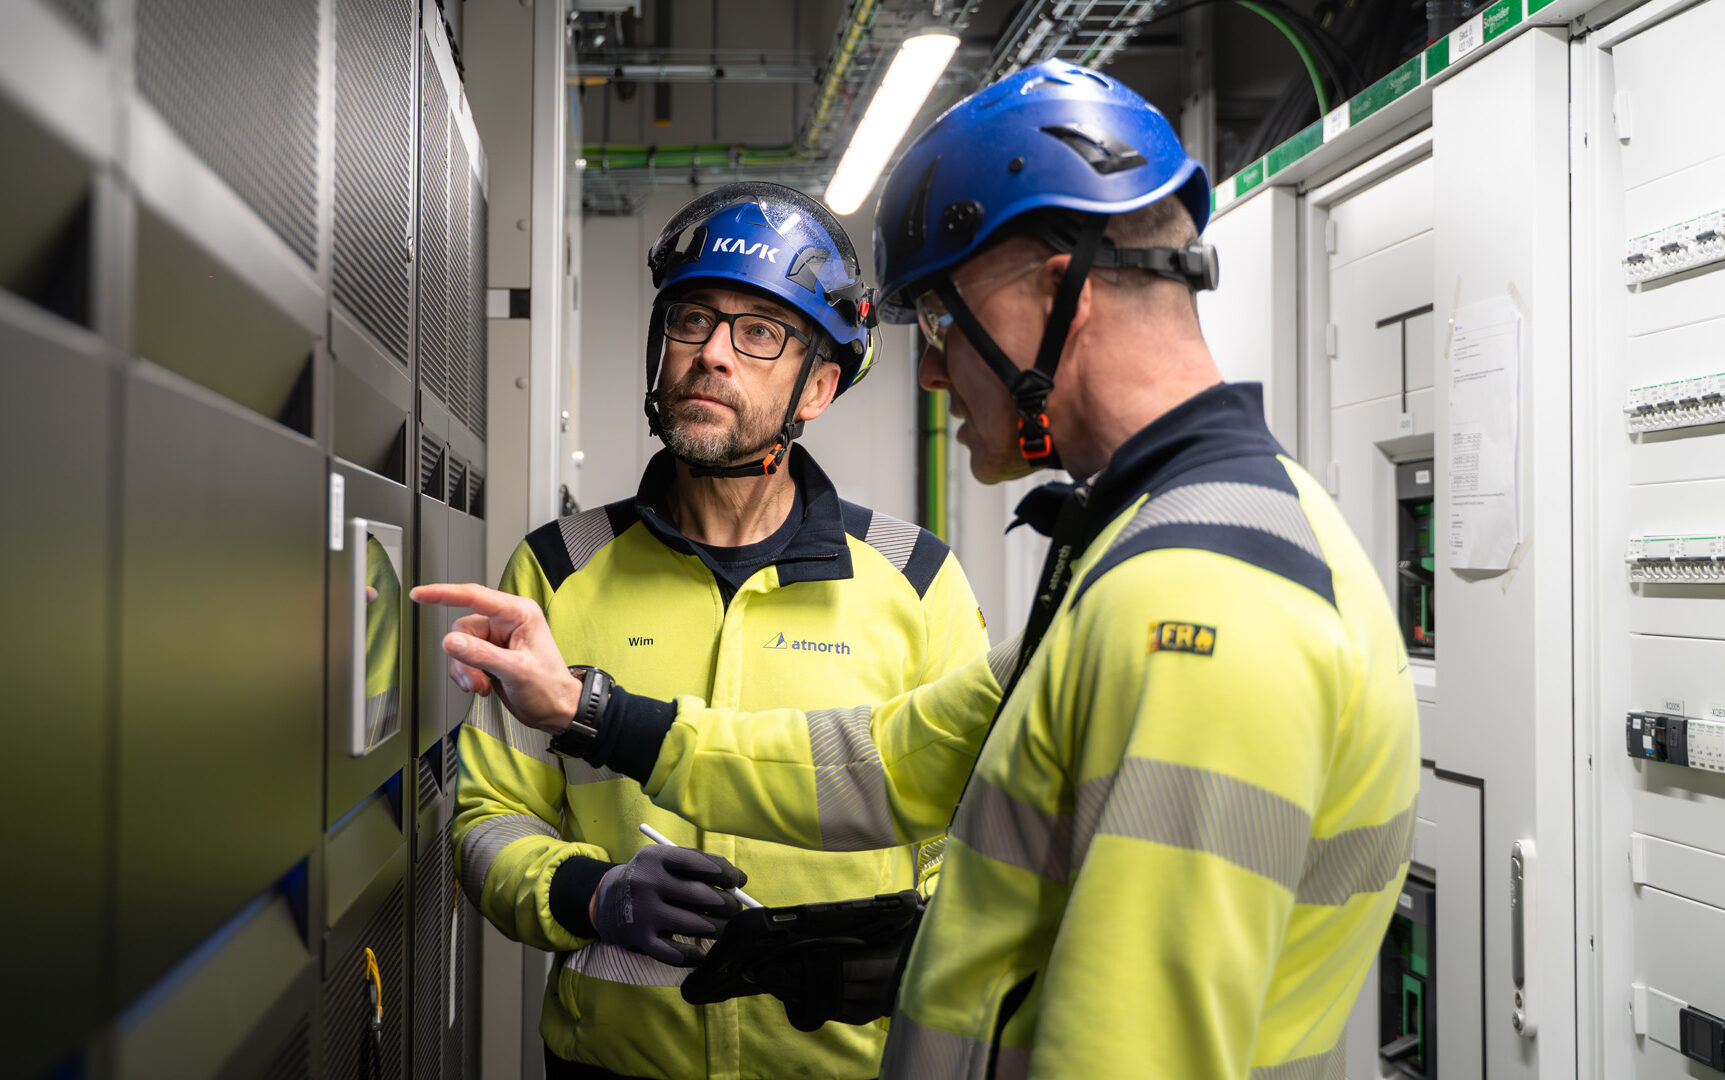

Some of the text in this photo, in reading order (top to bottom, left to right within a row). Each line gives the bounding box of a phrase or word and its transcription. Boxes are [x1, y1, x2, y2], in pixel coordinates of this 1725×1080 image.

[712, 237, 780, 263] KASK
[628, 636, 654, 646] Wim
[1161, 623, 1195, 647] FR
[791, 640, 850, 654] atnorth
